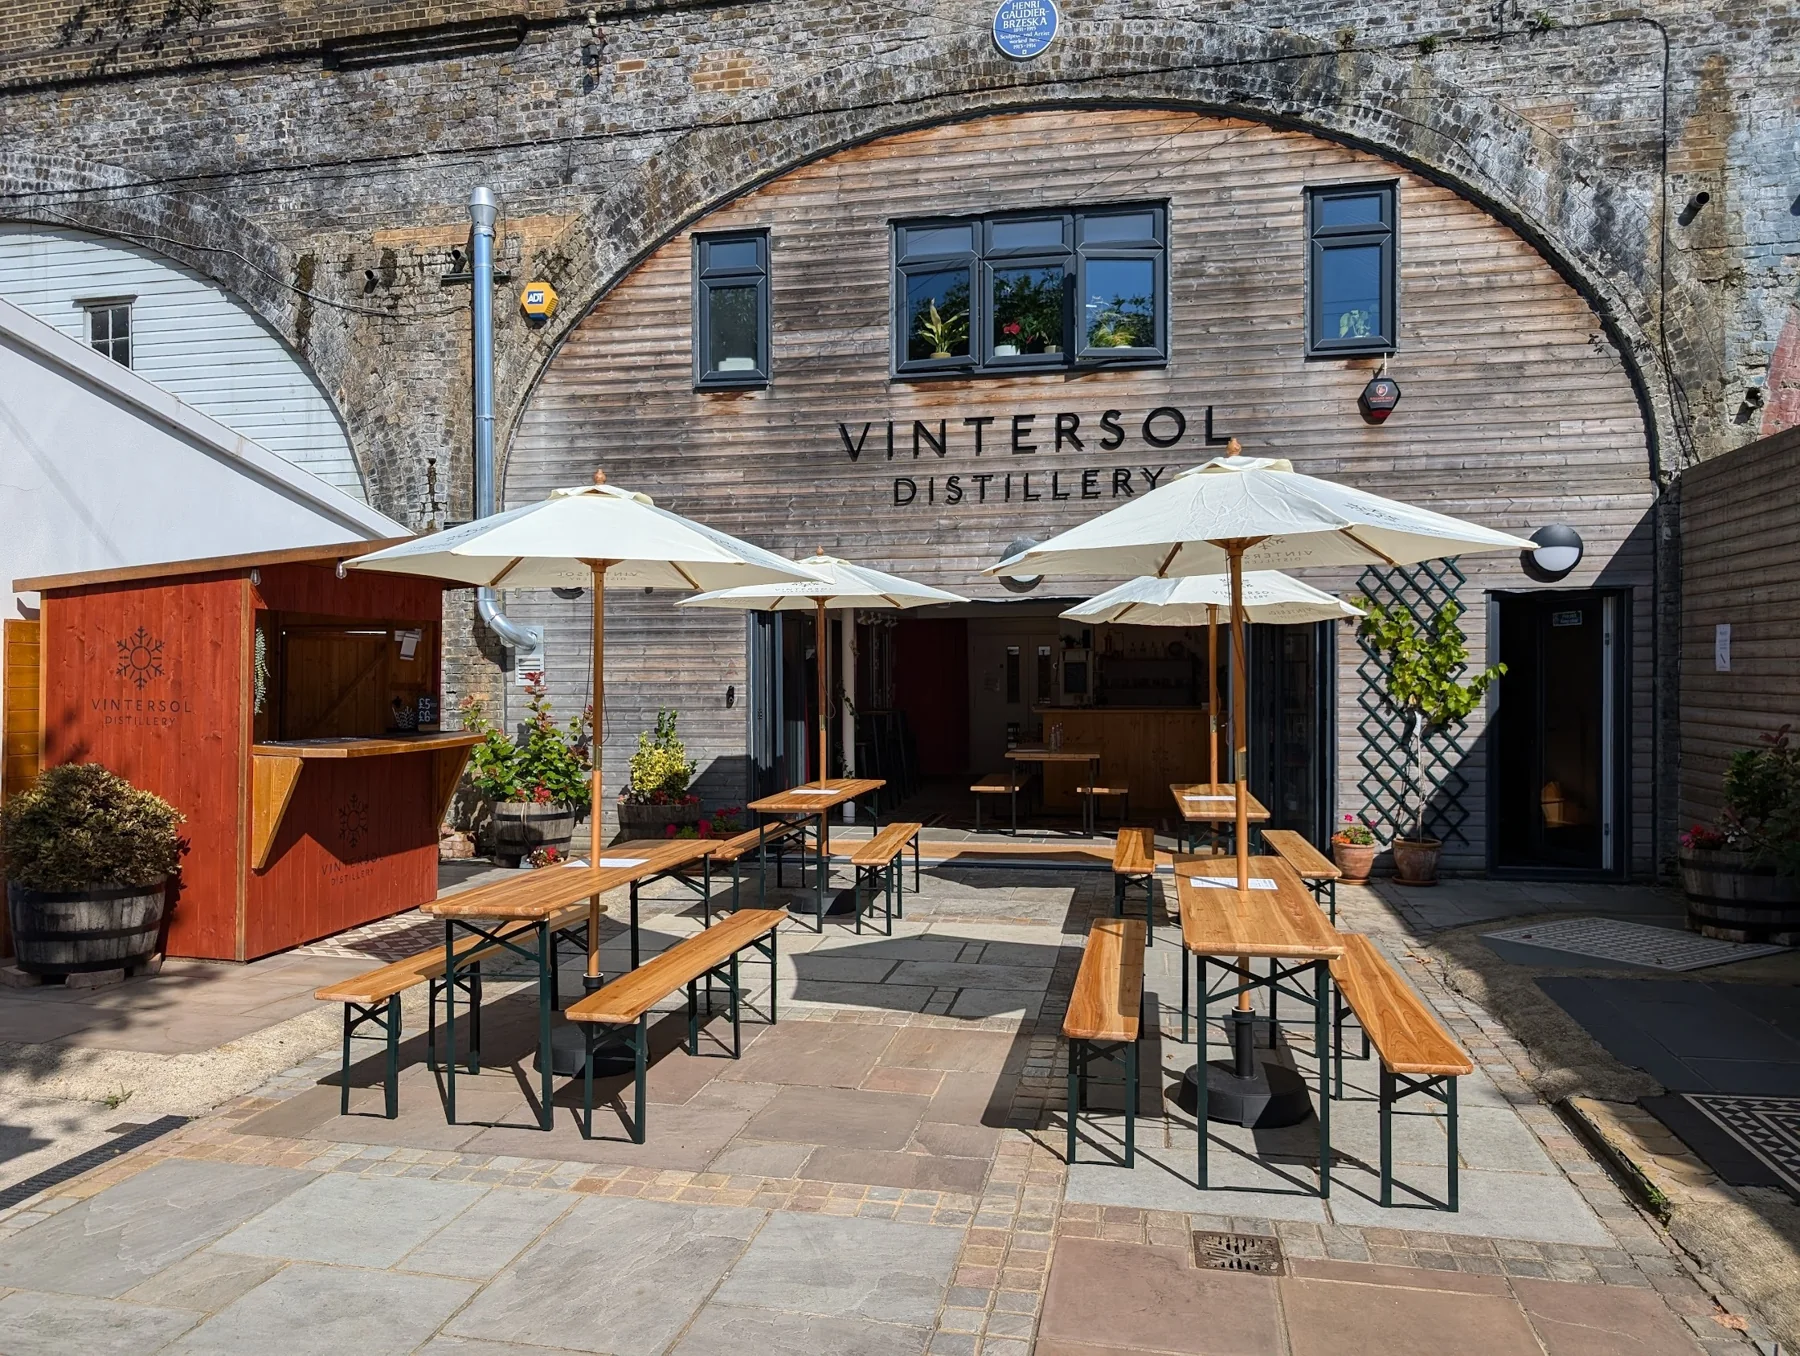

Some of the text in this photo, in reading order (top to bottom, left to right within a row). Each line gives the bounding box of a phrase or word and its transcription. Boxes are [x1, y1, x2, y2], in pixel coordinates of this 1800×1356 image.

[1012, 0, 1040, 10] HENRI
[1001, 8, 1050, 20] GAUDIER-
[1003, 17, 1047, 29] BRZESKA
[527, 292, 544, 303] ADT
[839, 405, 1232, 462] VINTERSOL
[893, 466, 1165, 507] DISTILLERY
[91, 698, 192, 713] VINTERSOL
[418, 698, 431, 709] £5
[105, 715, 176, 726] DISTILLERY
[418, 710, 431, 722] £6
[331, 867, 375, 886] DISTILLERY
